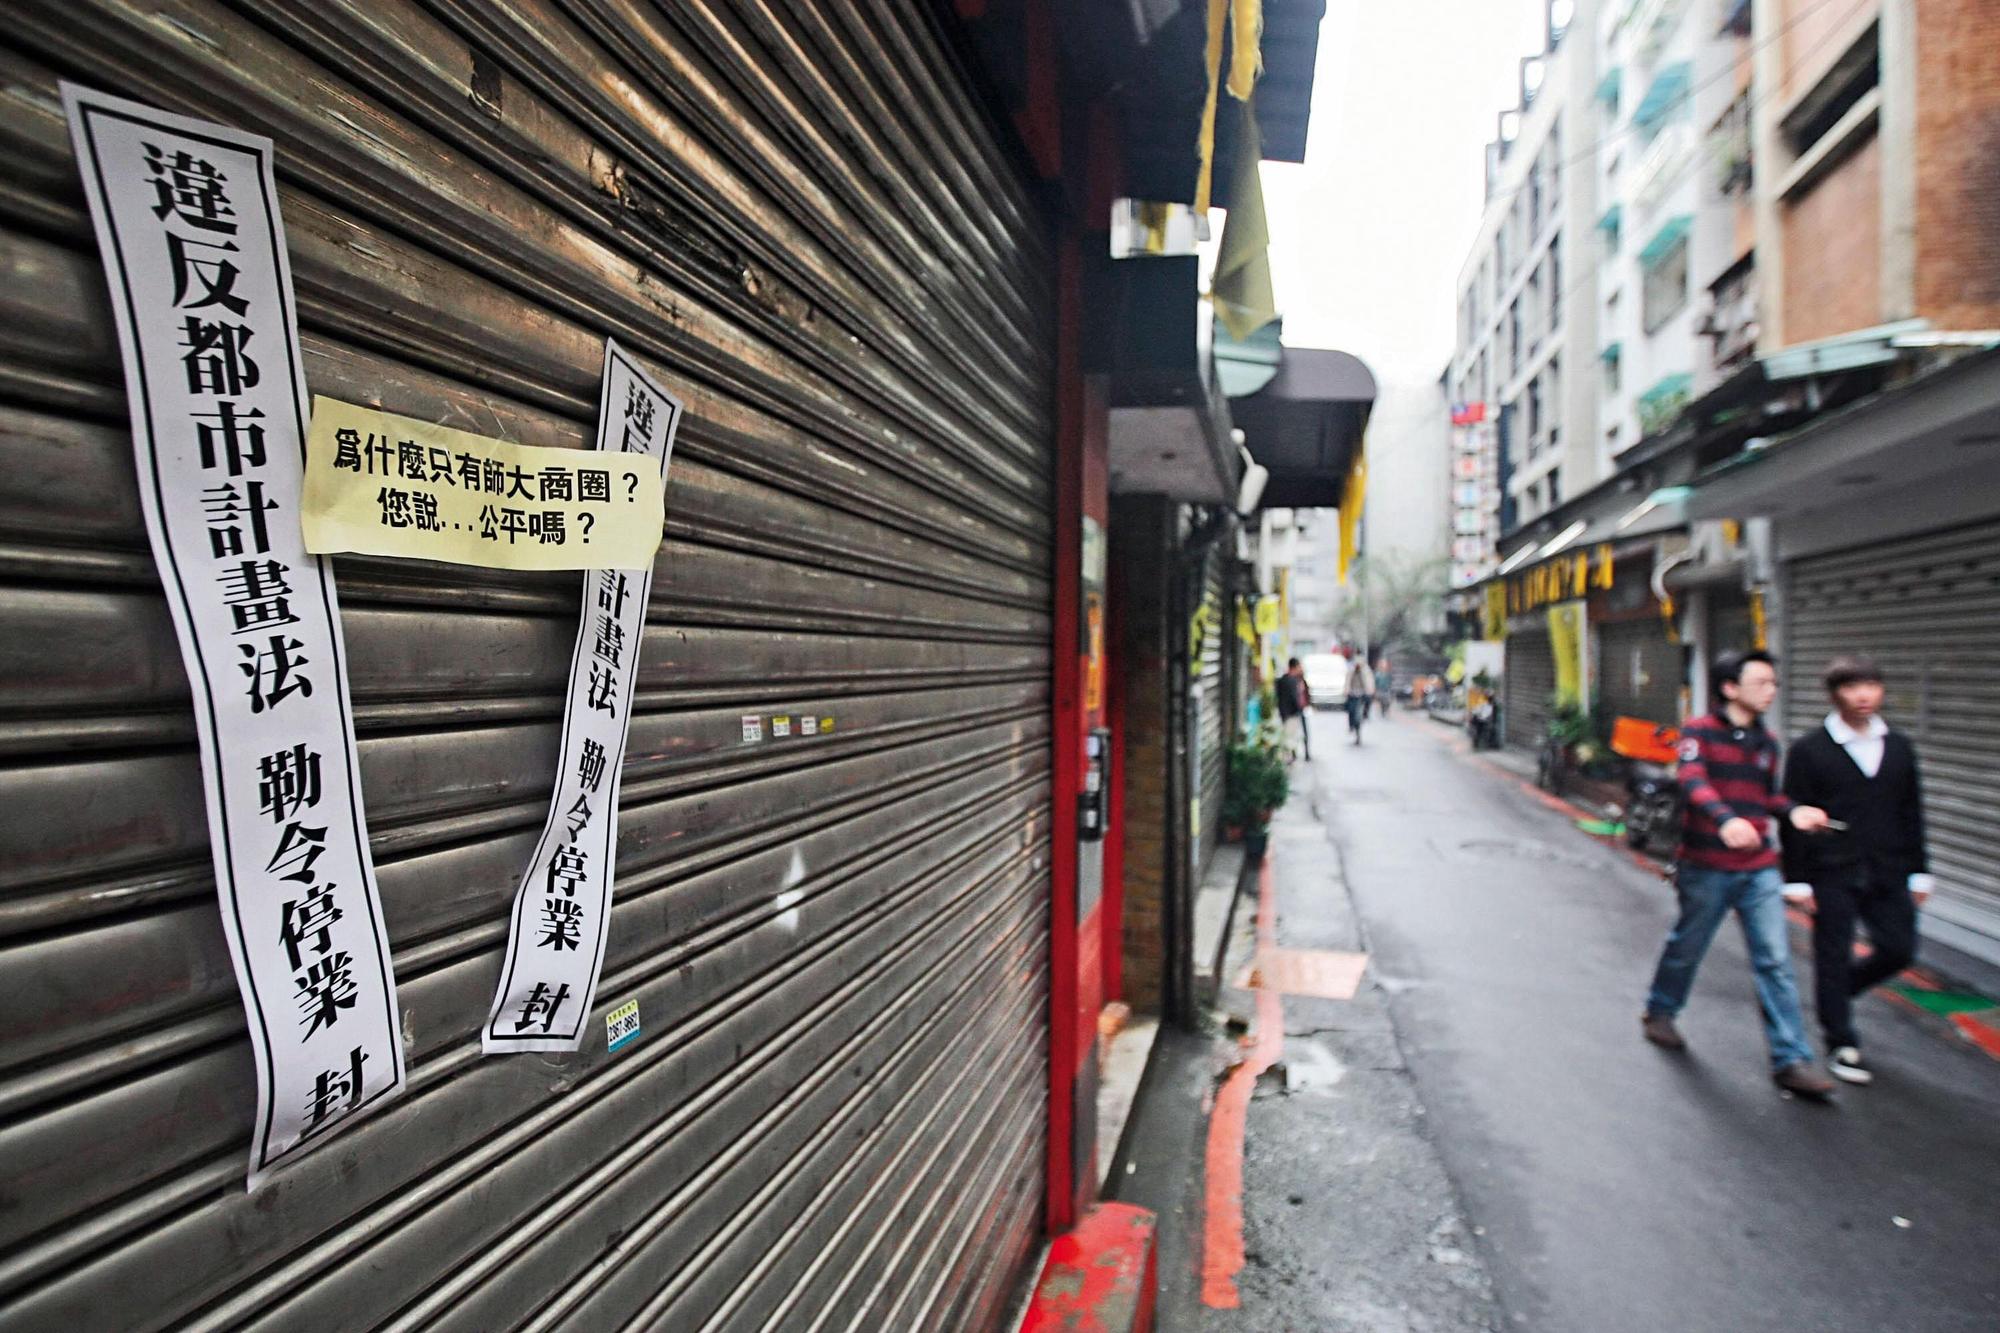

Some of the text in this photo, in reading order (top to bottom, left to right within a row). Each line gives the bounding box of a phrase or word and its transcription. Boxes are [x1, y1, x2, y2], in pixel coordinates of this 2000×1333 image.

[140, 140, 370, 1124] 違反都市計畫法 勒令停業 封
[537, 737, 607, 951] 勒令停業
[514, 982, 570, 1033] 封
